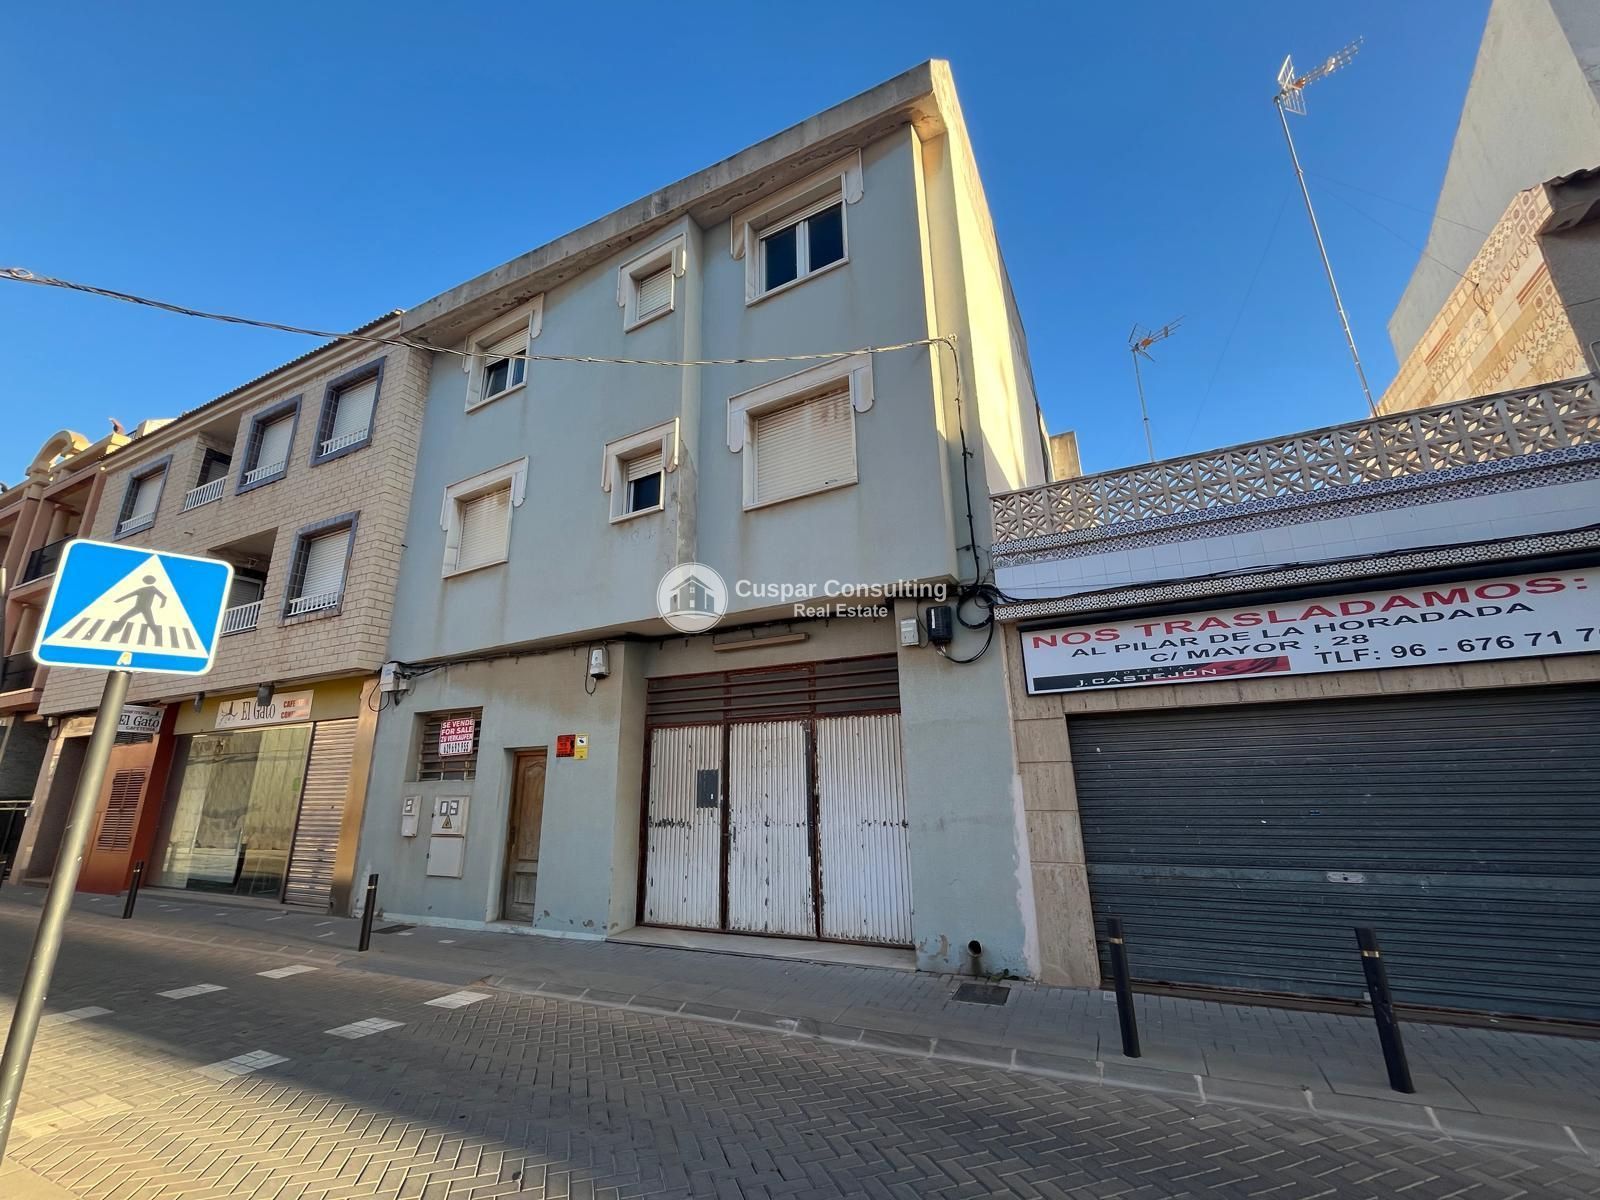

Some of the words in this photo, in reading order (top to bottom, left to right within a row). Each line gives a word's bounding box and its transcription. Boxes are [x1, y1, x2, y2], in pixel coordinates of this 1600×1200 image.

[1032, 627, 1121, 649] NOS
[1134, 577, 1588, 638] TRASLADAMOS:
[1071, 648, 1107, 658] AL
[1114, 636, 1200, 654] PILAR
[1209, 630, 1249, 645] DE
[1262, 626, 1305, 639] LA
[1314, 602, 1535, 634] HORADADA
[1150, 651, 1177, 663] C/
[1187, 640, 1303, 660] MAYOR
[1331, 634, 1370, 647] 28
[1314, 648, 1381, 665] TLF:
[1390, 643, 1427, 659] 96
[1457, 635, 1515, 652] 676
[1524, 630, 1562, 647] 71
[1576, 627, 1600, 642] 7
[119, 714, 130, 726] El
[133, 714, 160, 728] Gato
[240, 701, 251, 721] El
[253, 701, 276, 720] Gato
[441, 728, 455, 736] FOR
[456, 726, 474, 734] SALE
[442, 721, 451, 729] SE
[452, 719, 474, 728] VENDE
